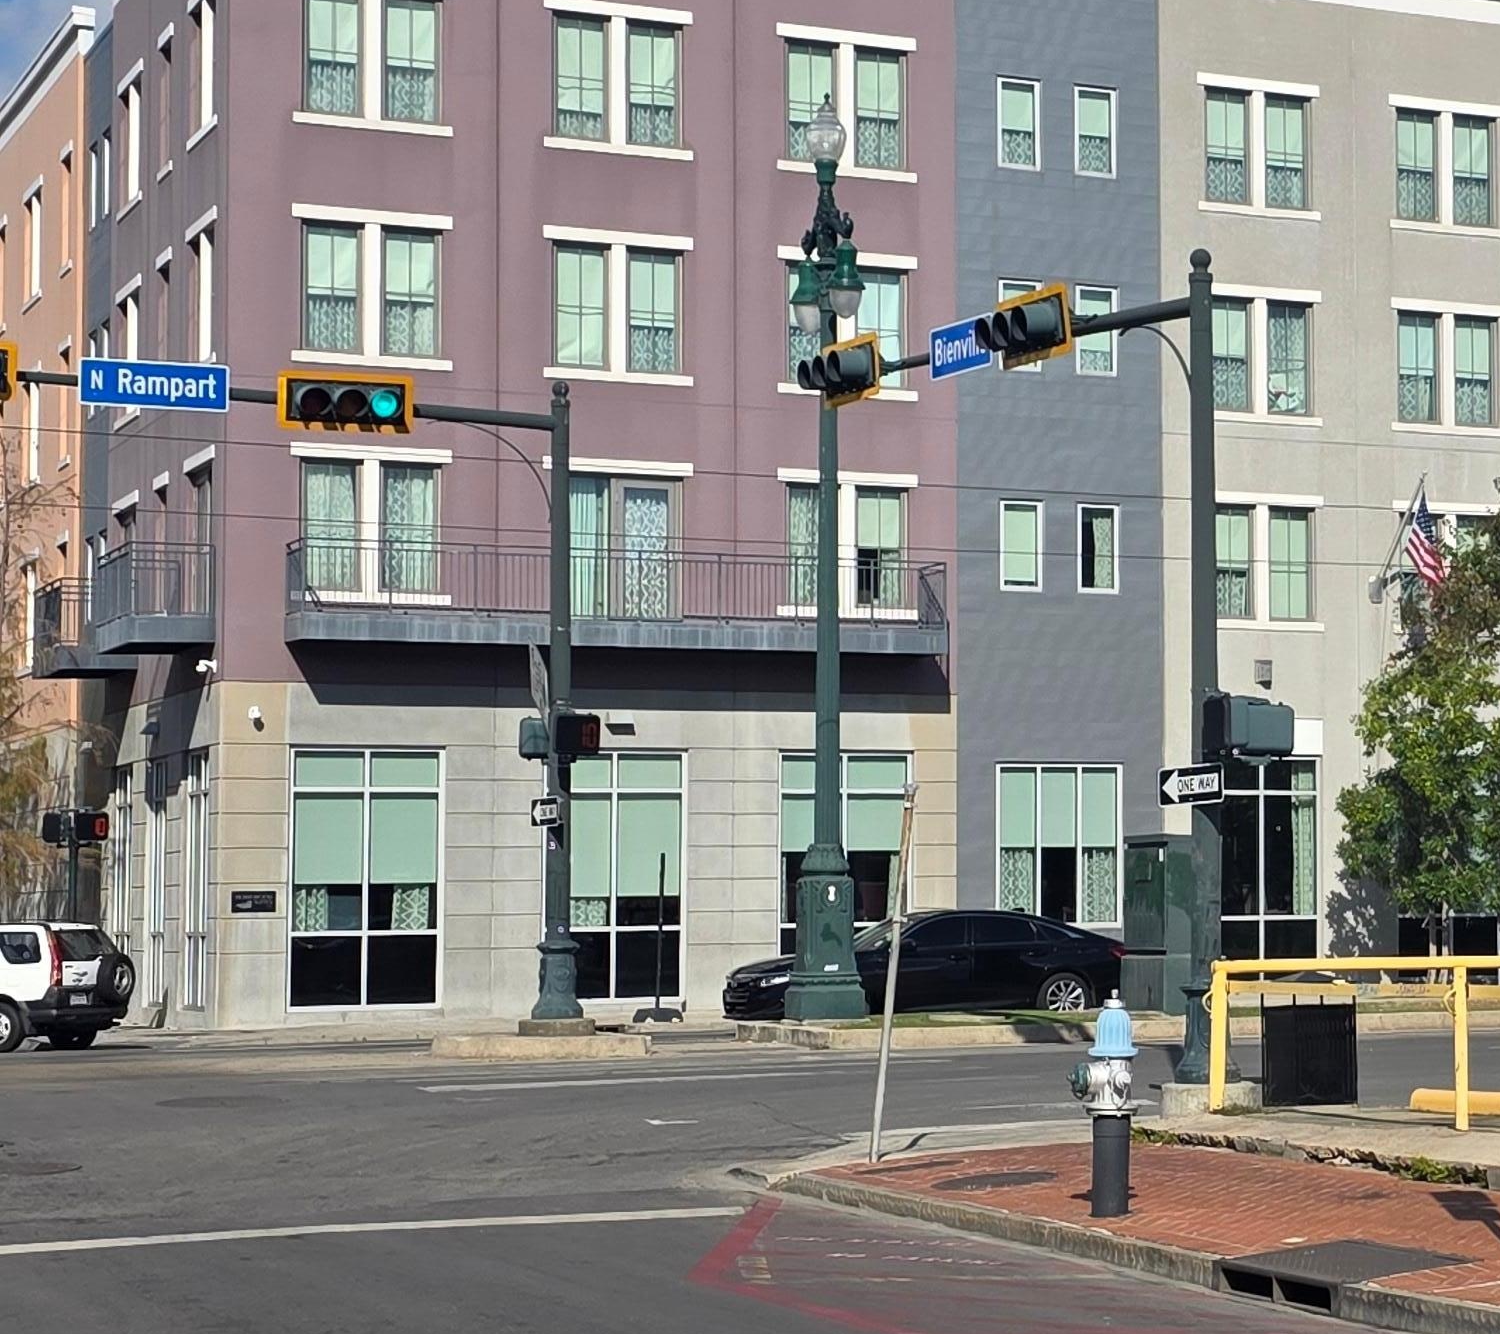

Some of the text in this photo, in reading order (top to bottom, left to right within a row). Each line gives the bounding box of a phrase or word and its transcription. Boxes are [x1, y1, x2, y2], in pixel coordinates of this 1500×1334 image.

[90, 367, 217, 402] N Rampart
[1177, 775, 1216, 793] ONE WAY
